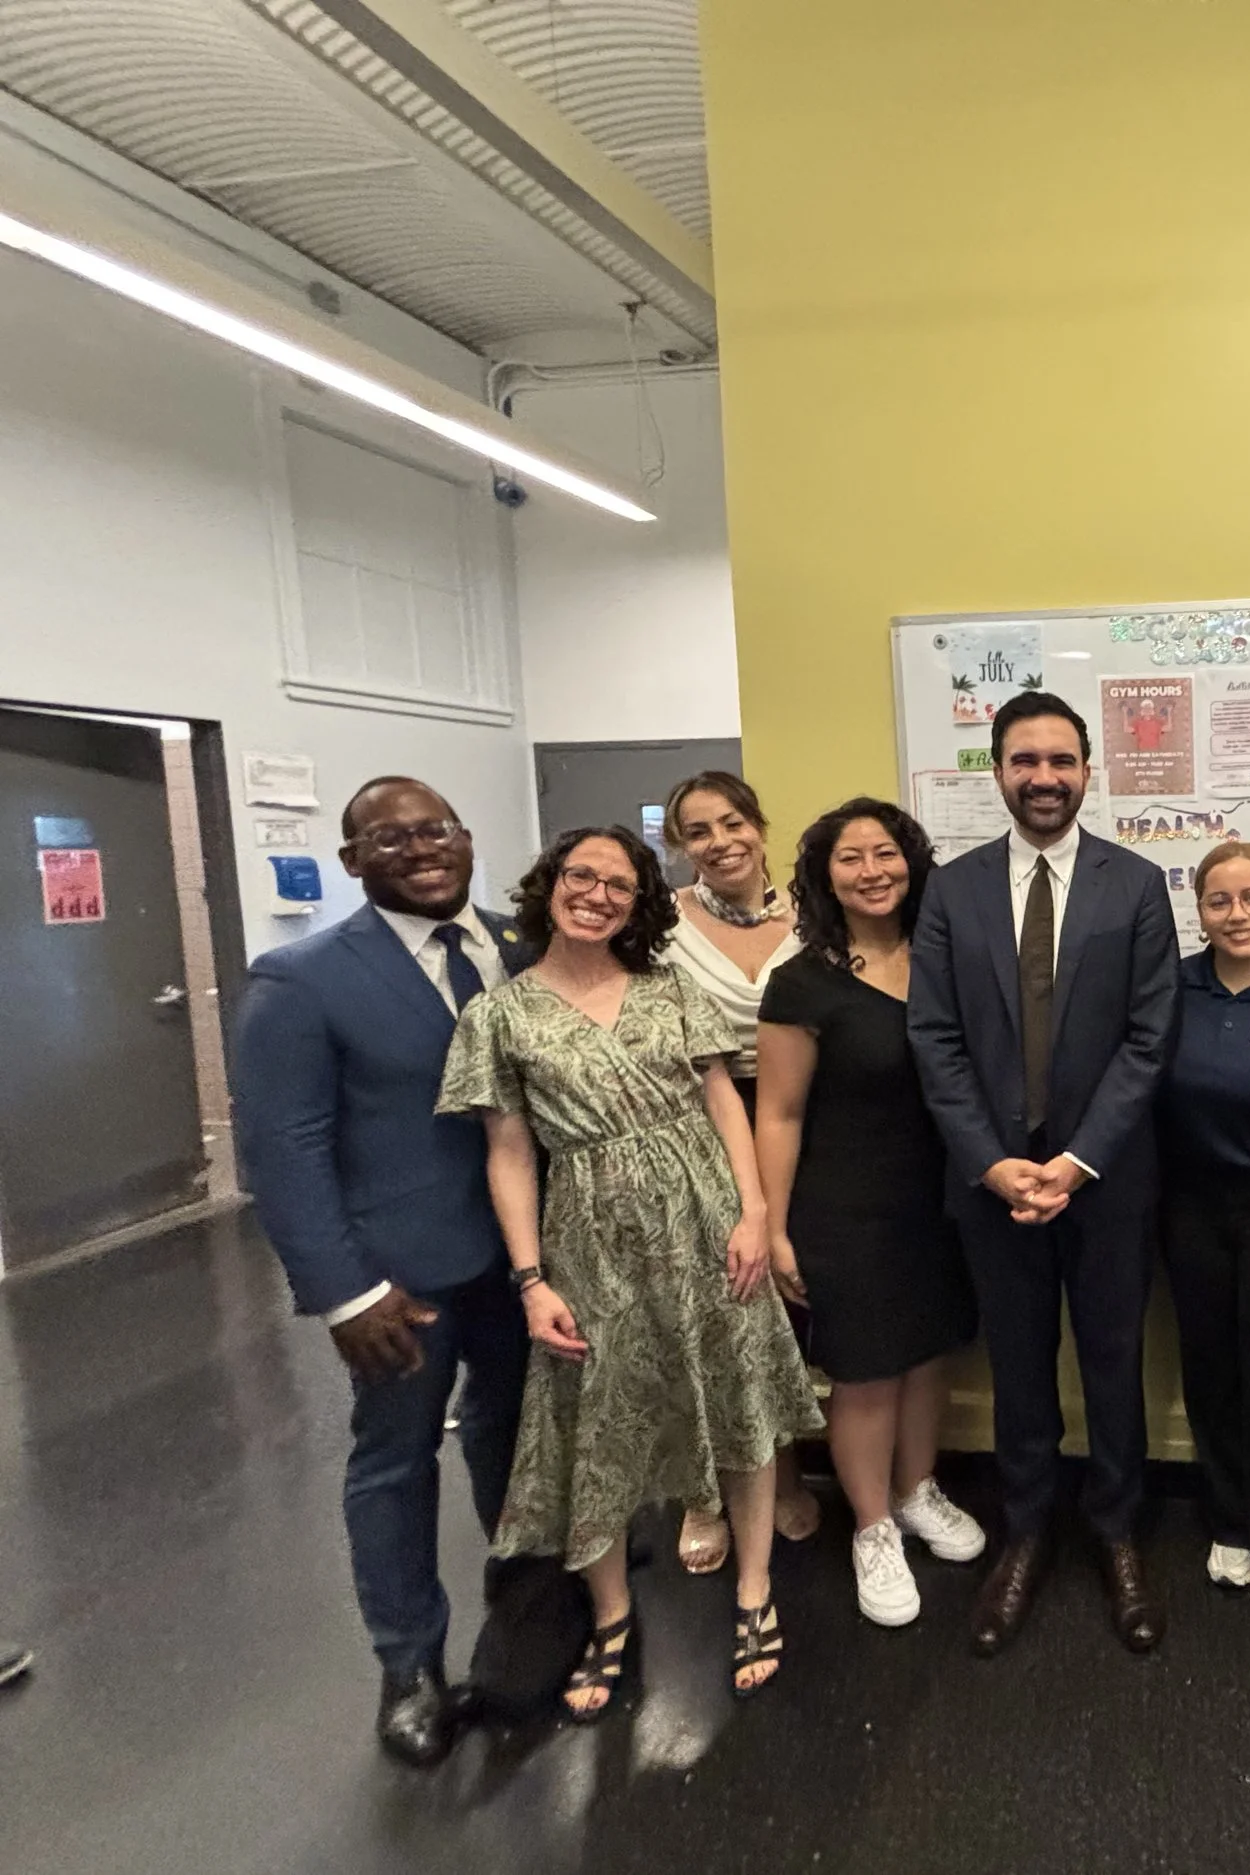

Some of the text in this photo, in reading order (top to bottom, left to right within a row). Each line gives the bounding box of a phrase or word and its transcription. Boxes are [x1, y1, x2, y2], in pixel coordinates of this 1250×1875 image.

[979, 663, 1015, 682] JULY
[1110, 685, 1183, 698] GYM HOURS
[1115, 814, 1226, 844] HEALTH
